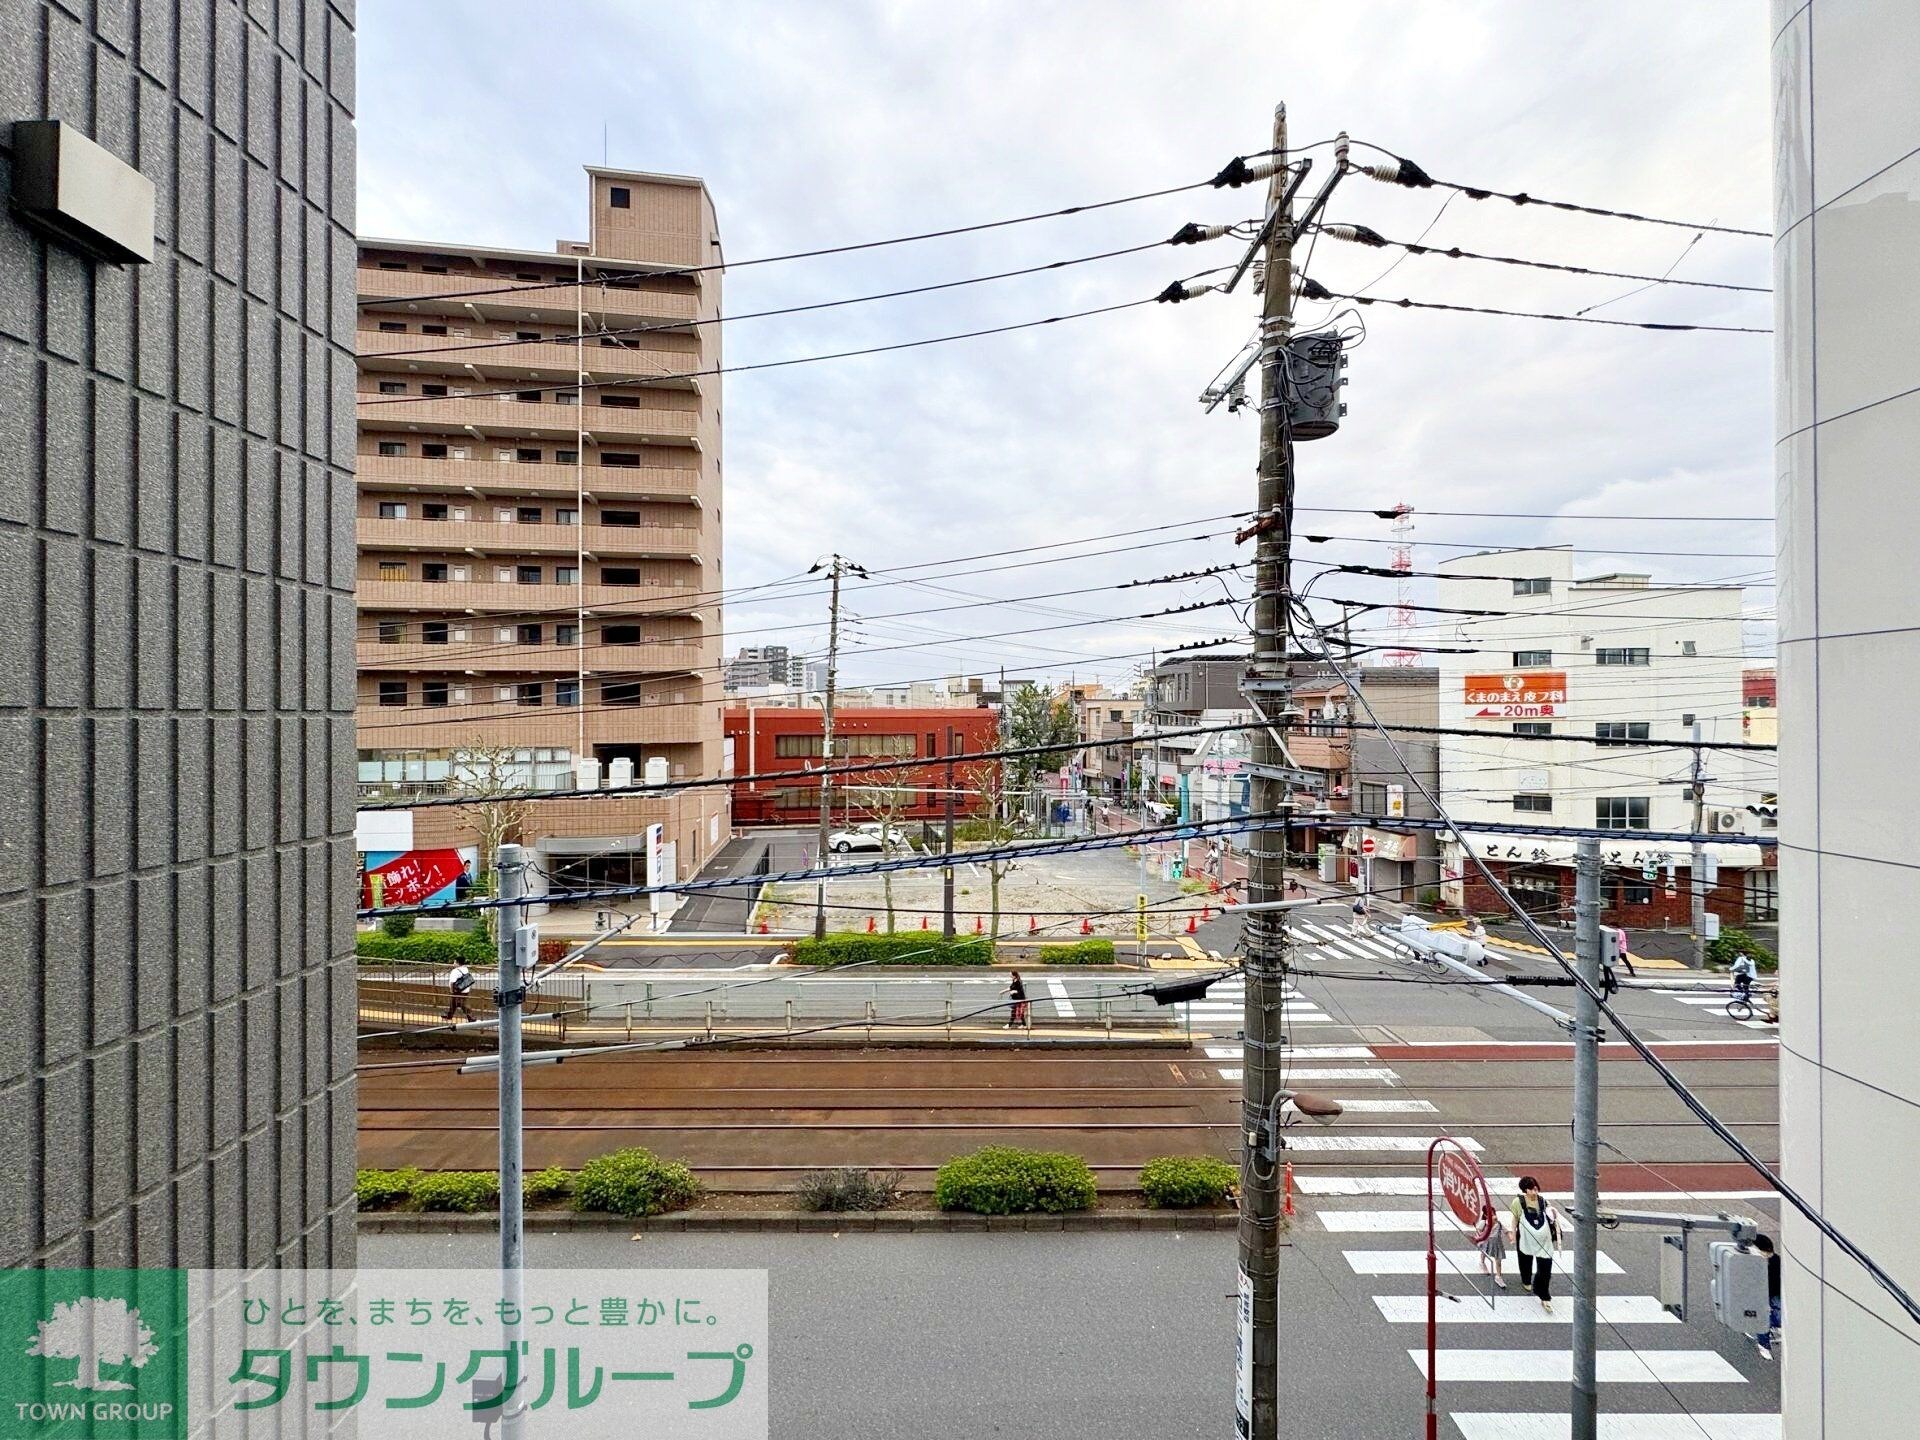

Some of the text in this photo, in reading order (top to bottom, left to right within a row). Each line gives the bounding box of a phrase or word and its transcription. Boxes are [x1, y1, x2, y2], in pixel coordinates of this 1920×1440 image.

[1503, 705, 1554, 717] 20m奥
[1442, 1163, 1478, 1217] 消火栓
